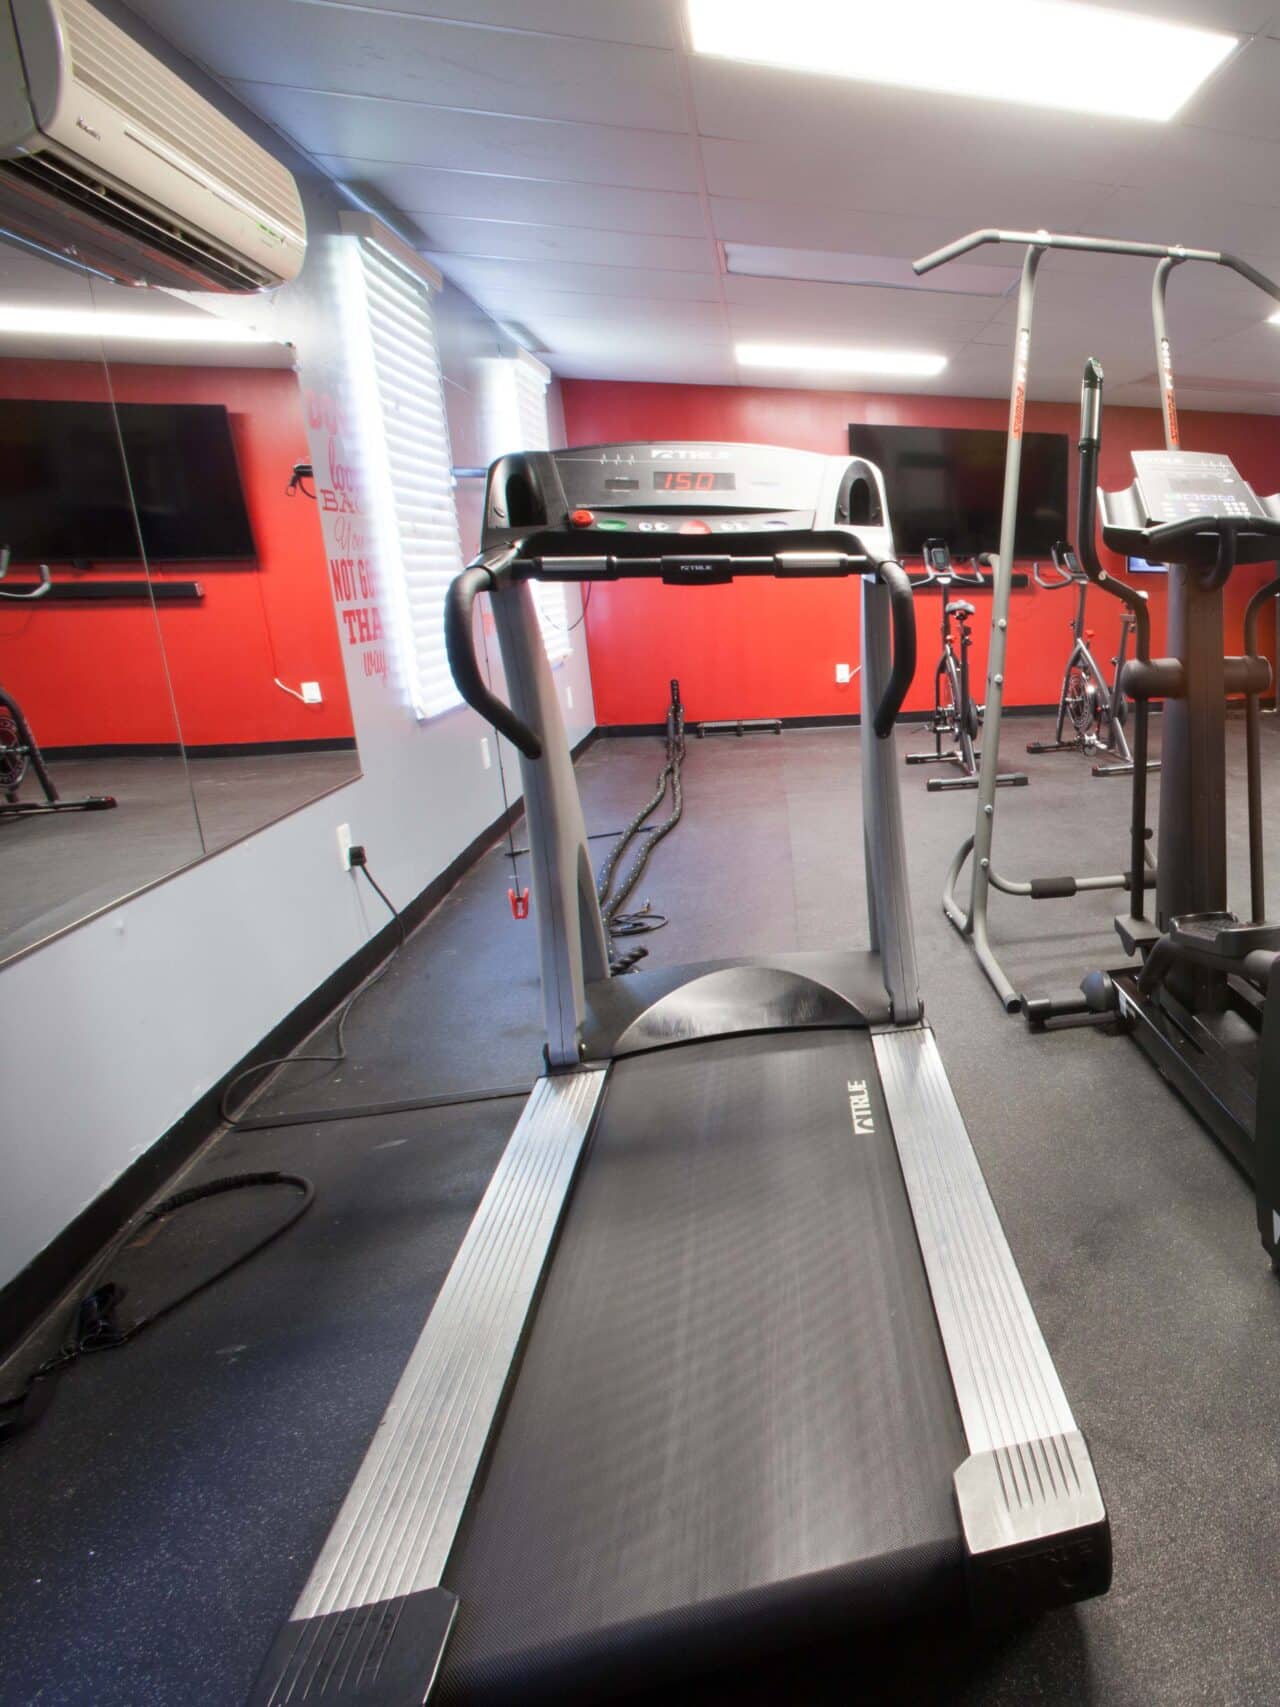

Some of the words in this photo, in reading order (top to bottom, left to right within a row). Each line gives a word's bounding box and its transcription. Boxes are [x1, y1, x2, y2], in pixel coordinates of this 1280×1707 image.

[663, 472, 715, 491] 150
[330, 559, 357, 602] NOT
[342, 607, 385, 645] THA
[847, 1079, 872, 1120] TRUE
